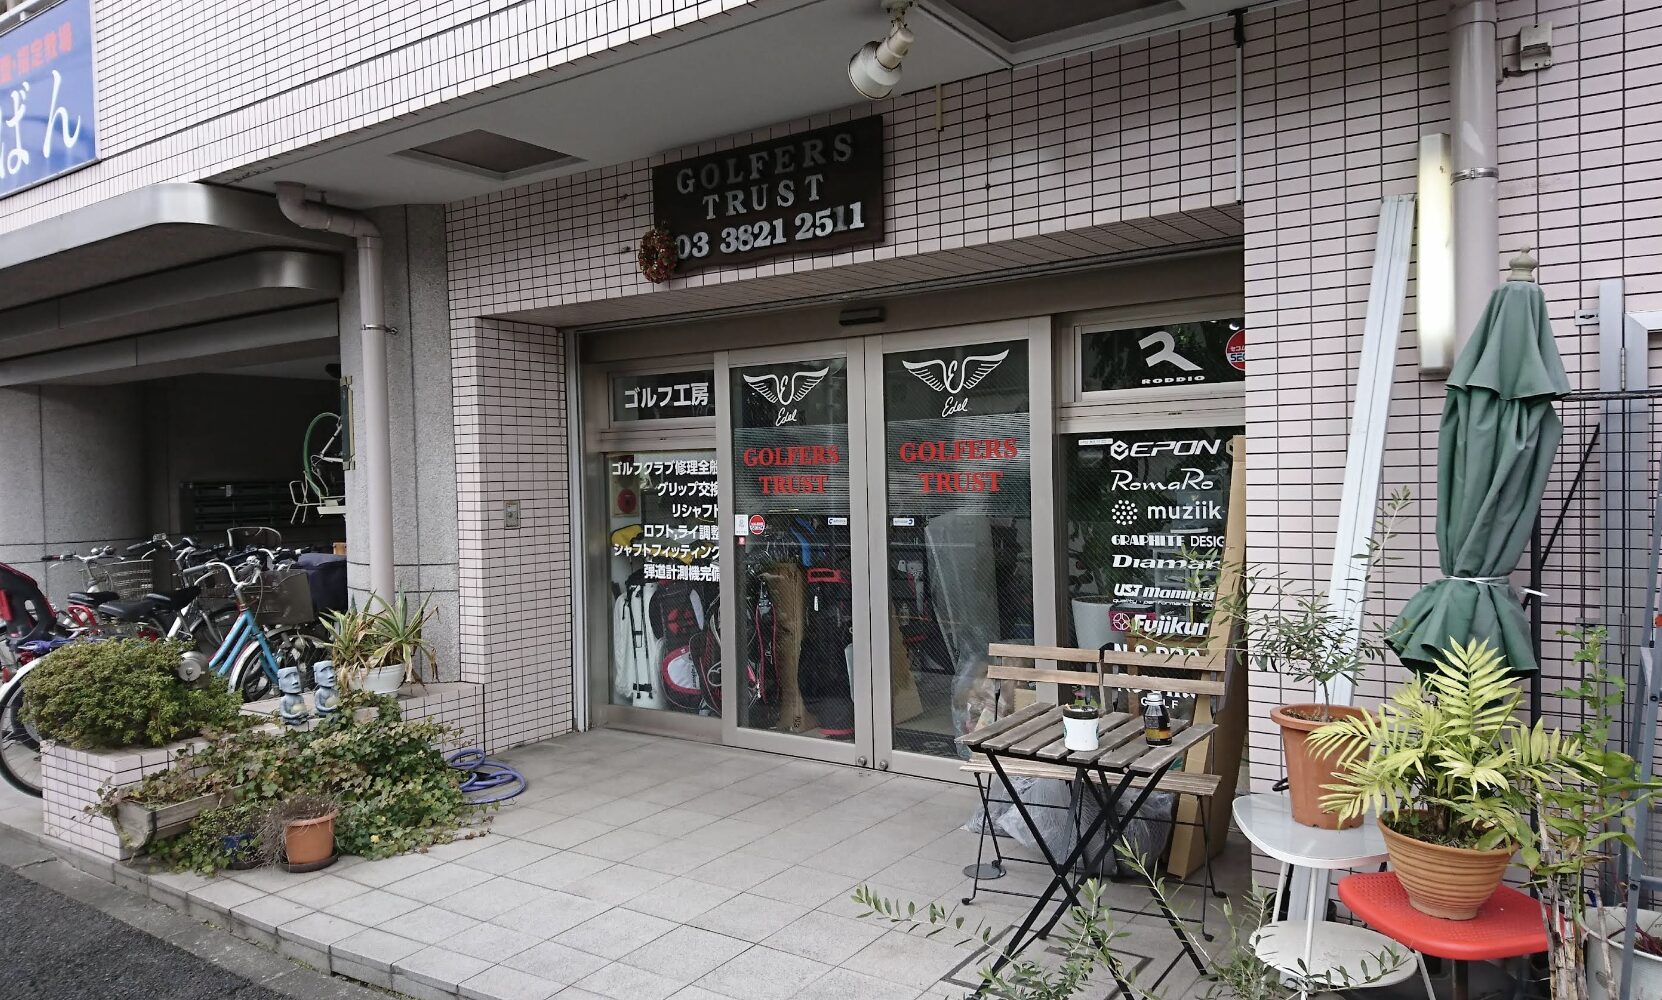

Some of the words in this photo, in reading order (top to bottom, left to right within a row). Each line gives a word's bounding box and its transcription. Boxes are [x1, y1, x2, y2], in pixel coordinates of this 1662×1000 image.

[676, 133, 853, 195] GOLFERS
[702, 173, 824, 220] TRUST
[675, 231, 710, 260] 03
[720, 217, 787, 253] 3821
[794, 201, 865, 241] 2511
[1141, 375, 1206, 385] RODDIO
[624, 382, 709, 409] ゴルフ工房
[775, 407, 797, 427] Edel
[942, 396, 968, 418] Edel
[743, 444, 840, 467] GOLFERS
[900, 437, 1018, 463] GOLFERS
[1129, 439, 1221, 457] EPON
[759, 475, 829, 495] TRUST
[918, 471, 1004, 493] TRUST
[1110, 467, 1214, 491] RomaRo
[1147, 500, 1222, 520] muziik
[1111, 534, 1185, 547] GRAPHITE
[1113, 583, 1143, 597] UST
[1140, 696, 1179, 710] GLF
